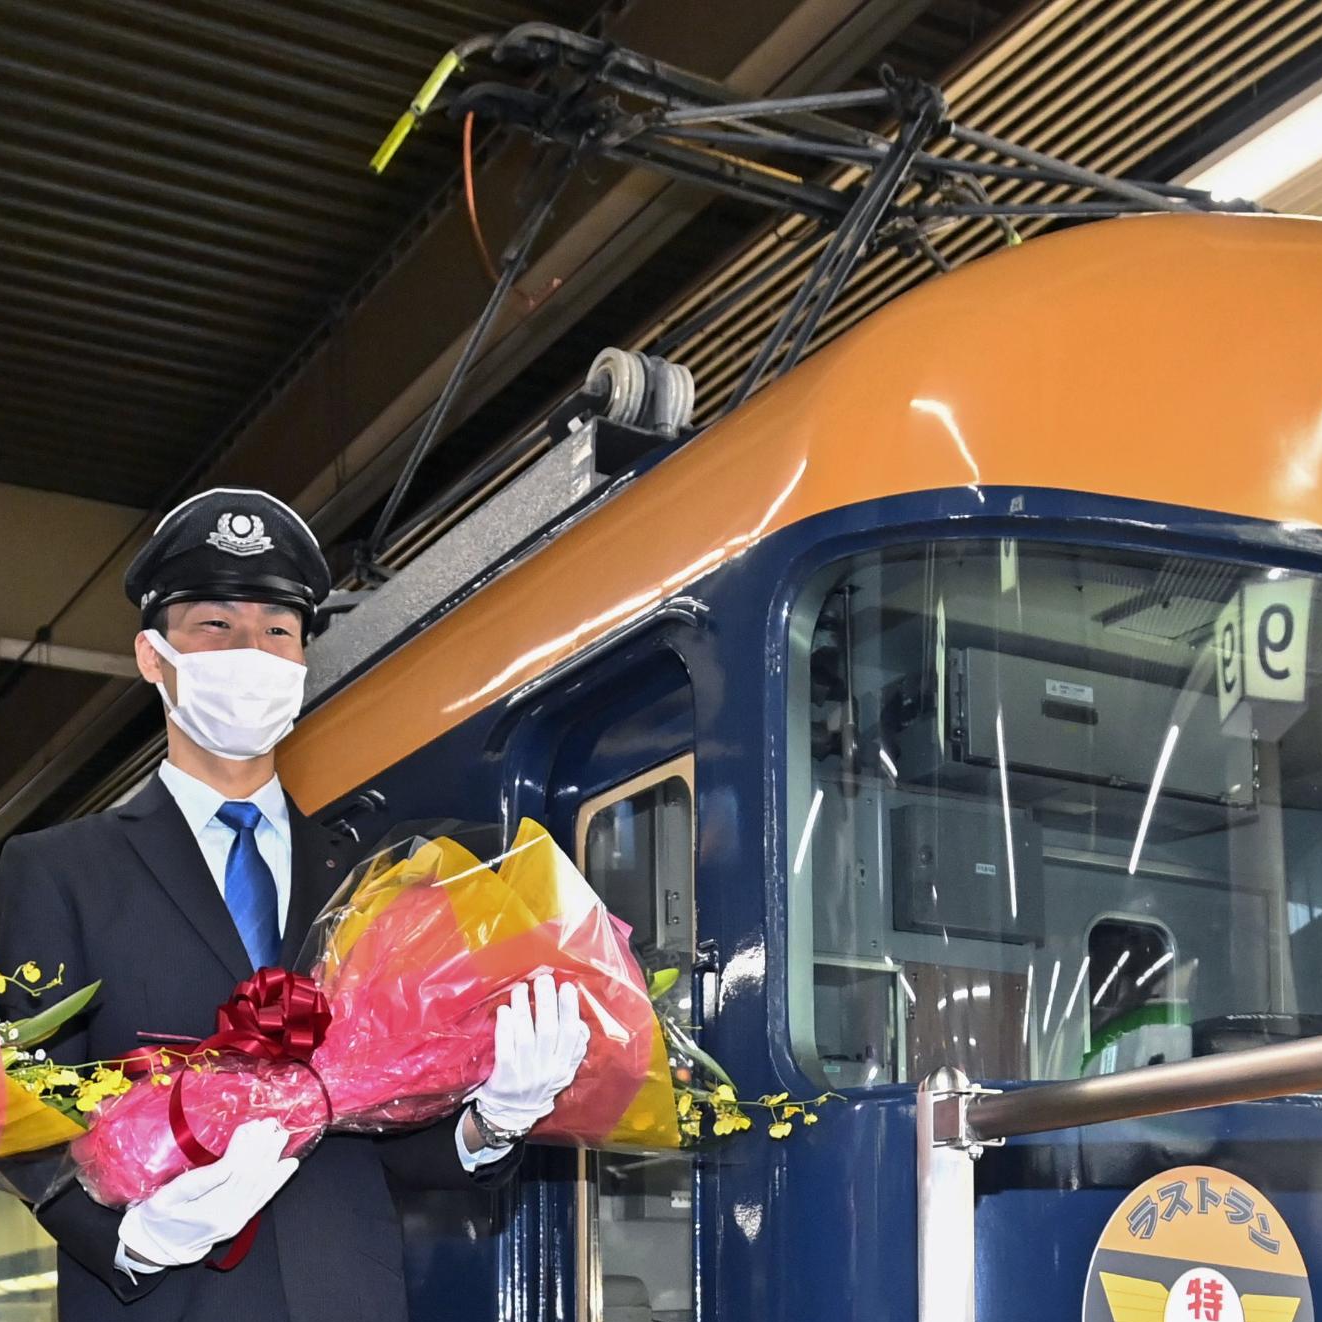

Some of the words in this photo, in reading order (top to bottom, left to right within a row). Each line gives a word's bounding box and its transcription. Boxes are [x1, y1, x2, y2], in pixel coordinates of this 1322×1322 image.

[1127, 1177, 1280, 1254] ラストラン
